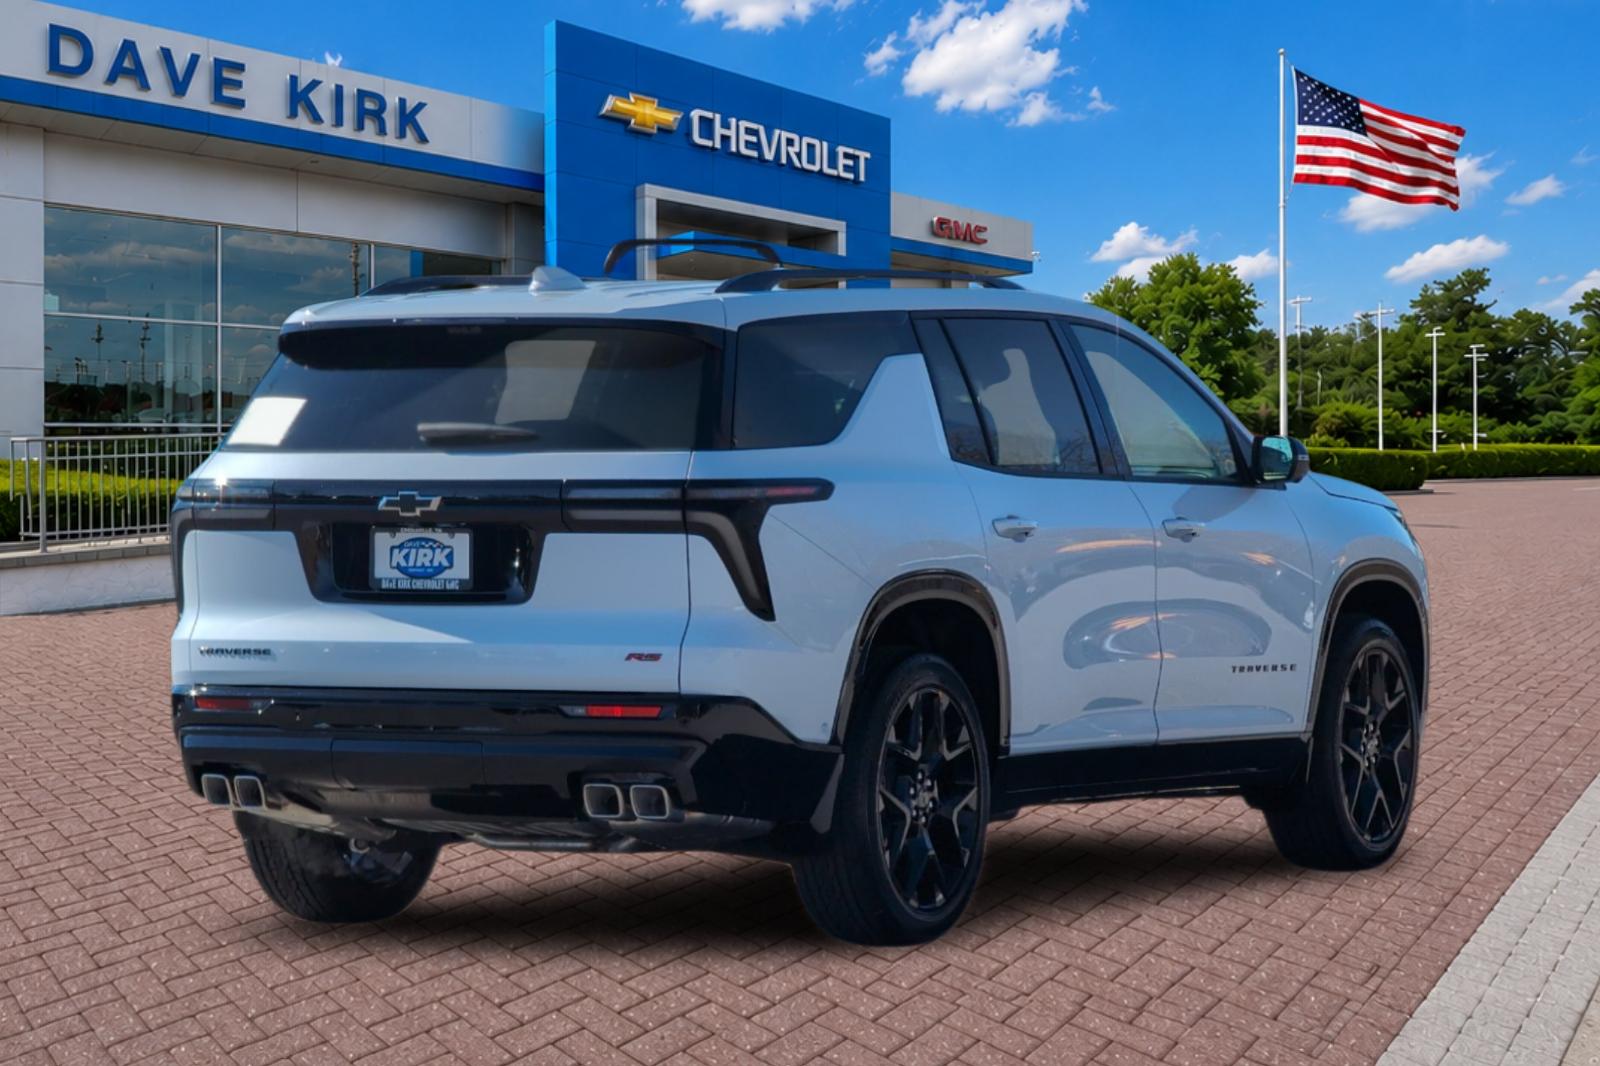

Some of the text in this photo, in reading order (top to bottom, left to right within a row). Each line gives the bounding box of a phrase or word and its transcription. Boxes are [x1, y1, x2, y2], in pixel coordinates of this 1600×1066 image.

[47, 23, 430, 144] DAVE KIRK
[690, 109, 871, 182] CHEVROLET
[931, 216, 988, 245] GMC
[391, 547, 452, 567] KIRK
[398, 579, 411, 589] KIRK
[412, 579, 445, 589] CHEVROLET
[624, 653, 663, 661] RS
[1231, 664, 1297, 673] TRAVERSE
